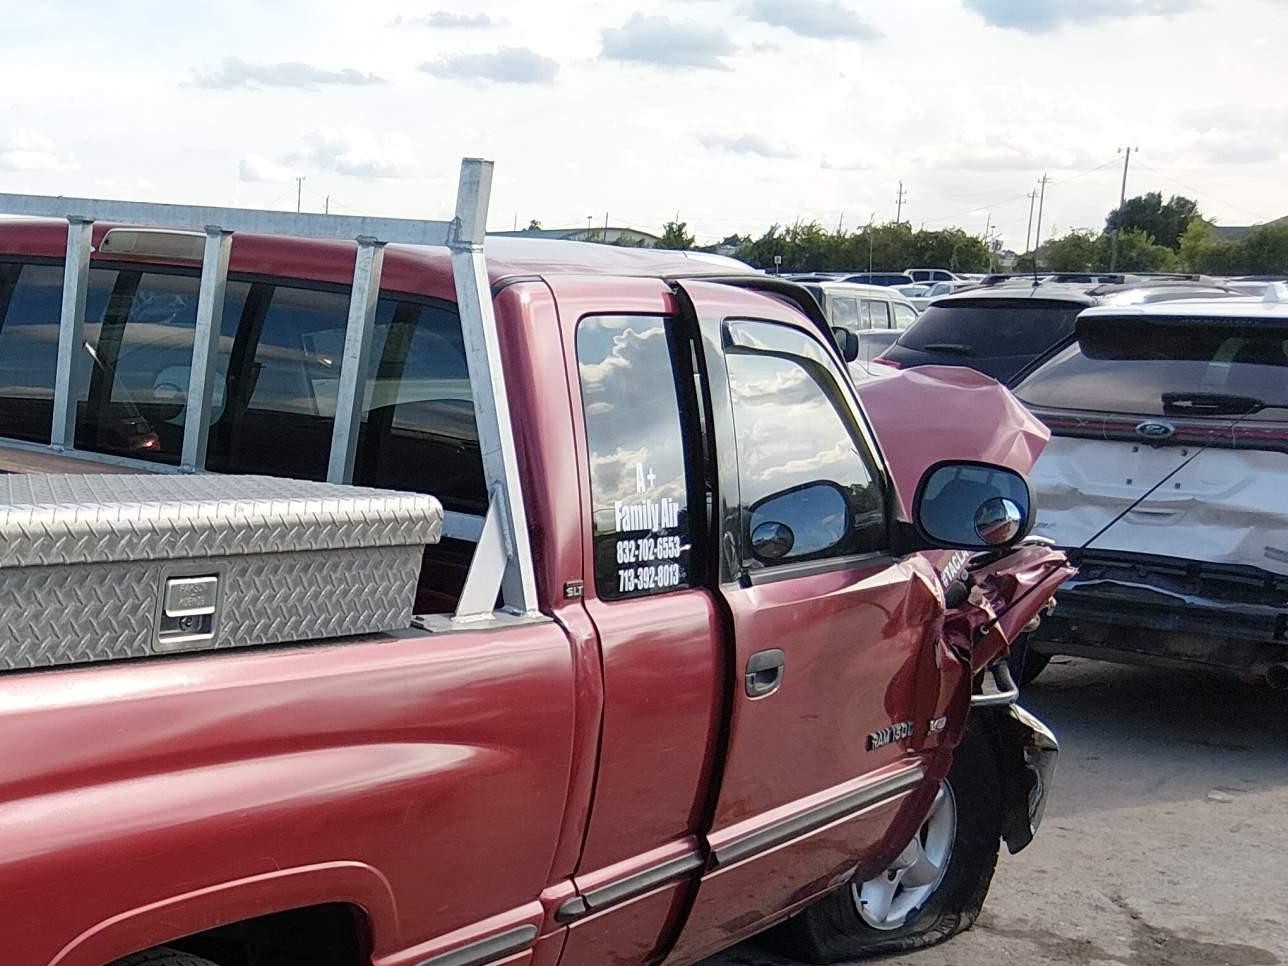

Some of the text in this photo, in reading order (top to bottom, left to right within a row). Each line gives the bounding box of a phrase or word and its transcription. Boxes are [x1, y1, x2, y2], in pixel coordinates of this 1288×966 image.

[636, 462, 657, 493] A+
[614, 497, 679, 532] Family Air
[616, 536, 681, 564] 832-702-6553
[565, 585, 584, 597] SLT
[618, 563, 680, 592] 713-392-8013
